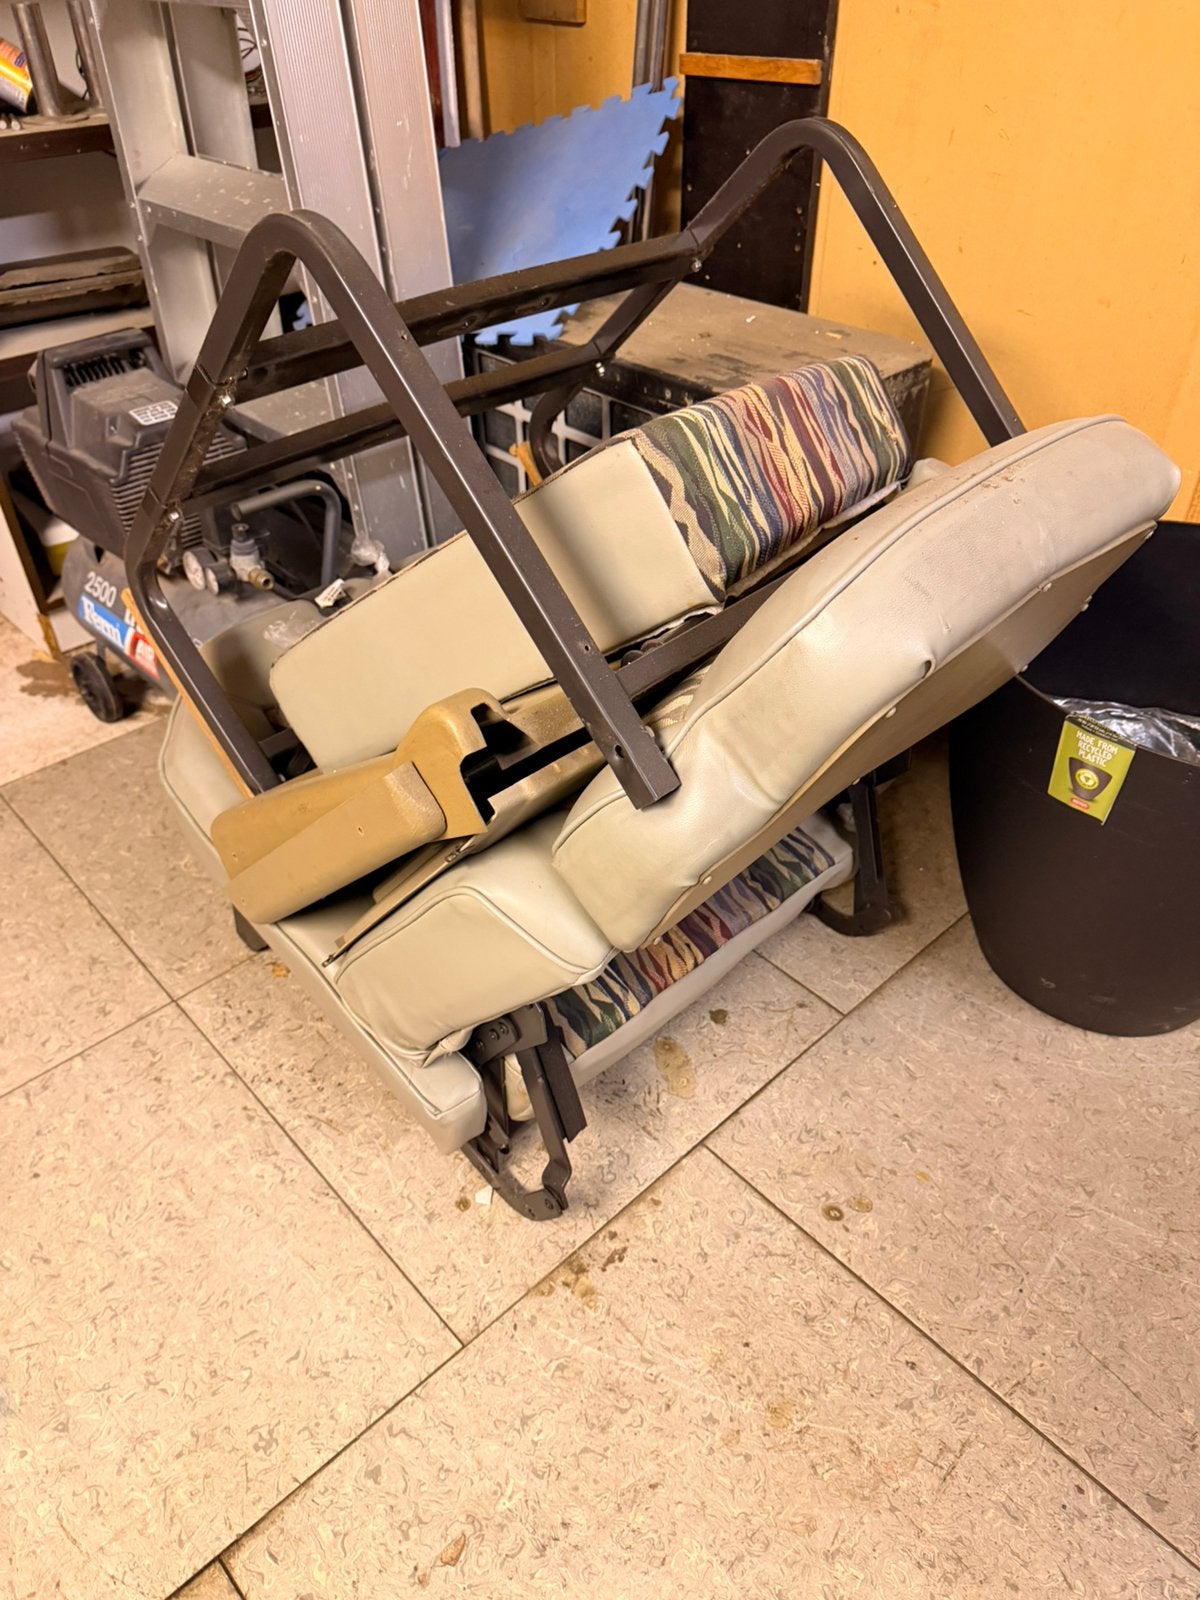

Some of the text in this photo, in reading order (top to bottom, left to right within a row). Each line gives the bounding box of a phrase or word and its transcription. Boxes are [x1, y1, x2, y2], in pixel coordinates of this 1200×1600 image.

[84, 571, 117, 608] 2500
[1076, 730, 1095, 745] MADE
[1098, 740, 1118, 755] FROM
[1078, 740, 1112, 760] RECYCLED
[1078, 749, 1107, 768] PLASTIC
